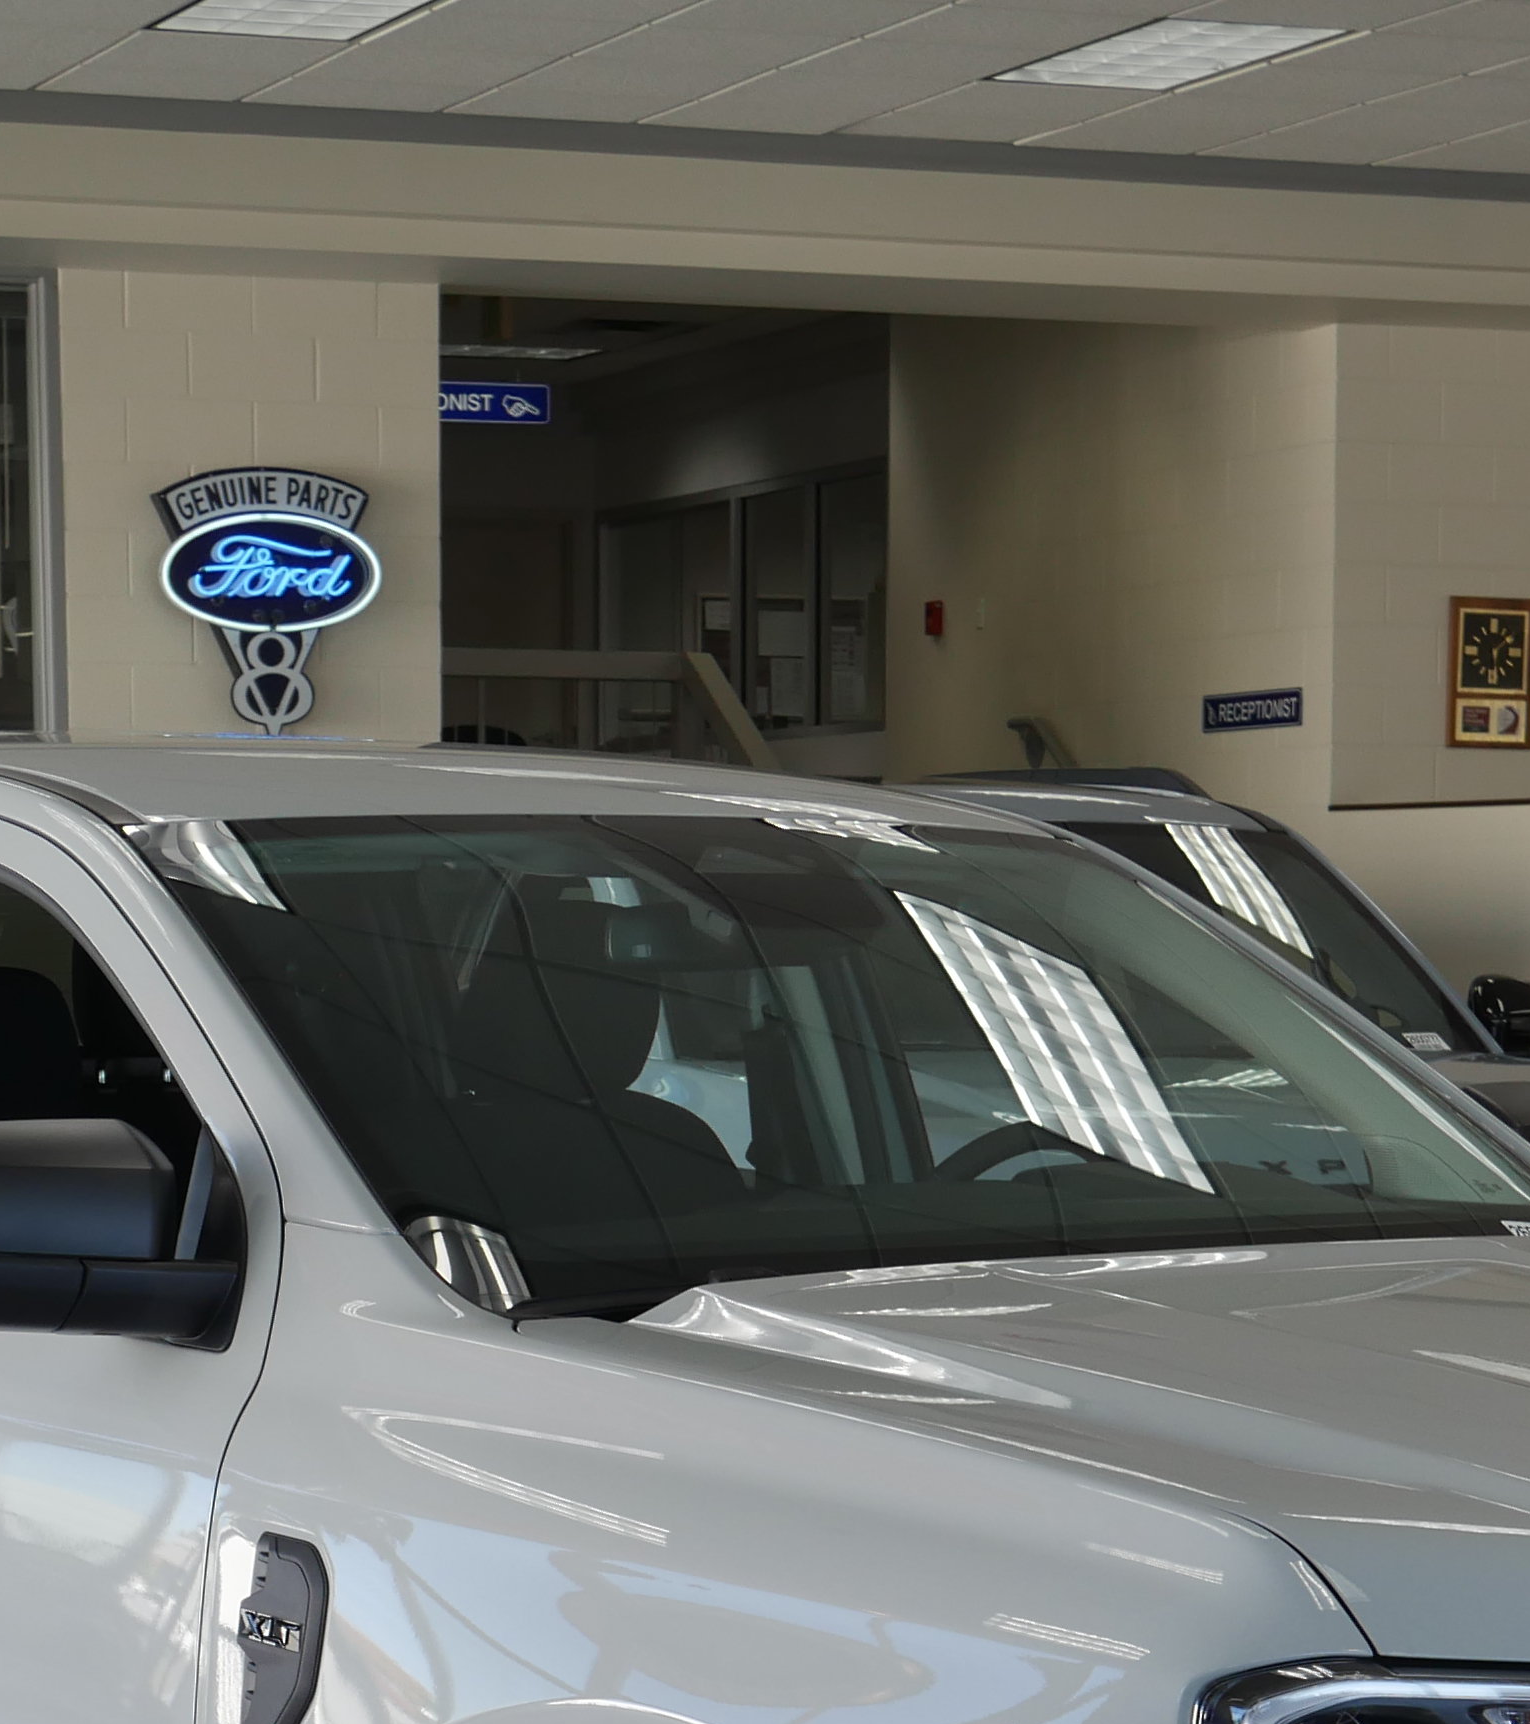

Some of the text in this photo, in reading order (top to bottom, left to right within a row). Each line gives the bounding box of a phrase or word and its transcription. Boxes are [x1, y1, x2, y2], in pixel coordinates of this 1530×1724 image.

[175, 475, 357, 520] GENUINE PARTS
[188, 535, 352, 601] Ford
[1219, 697, 1297, 722] RECEPTIONIST
[238, 1608, 303, 1652] XLT
